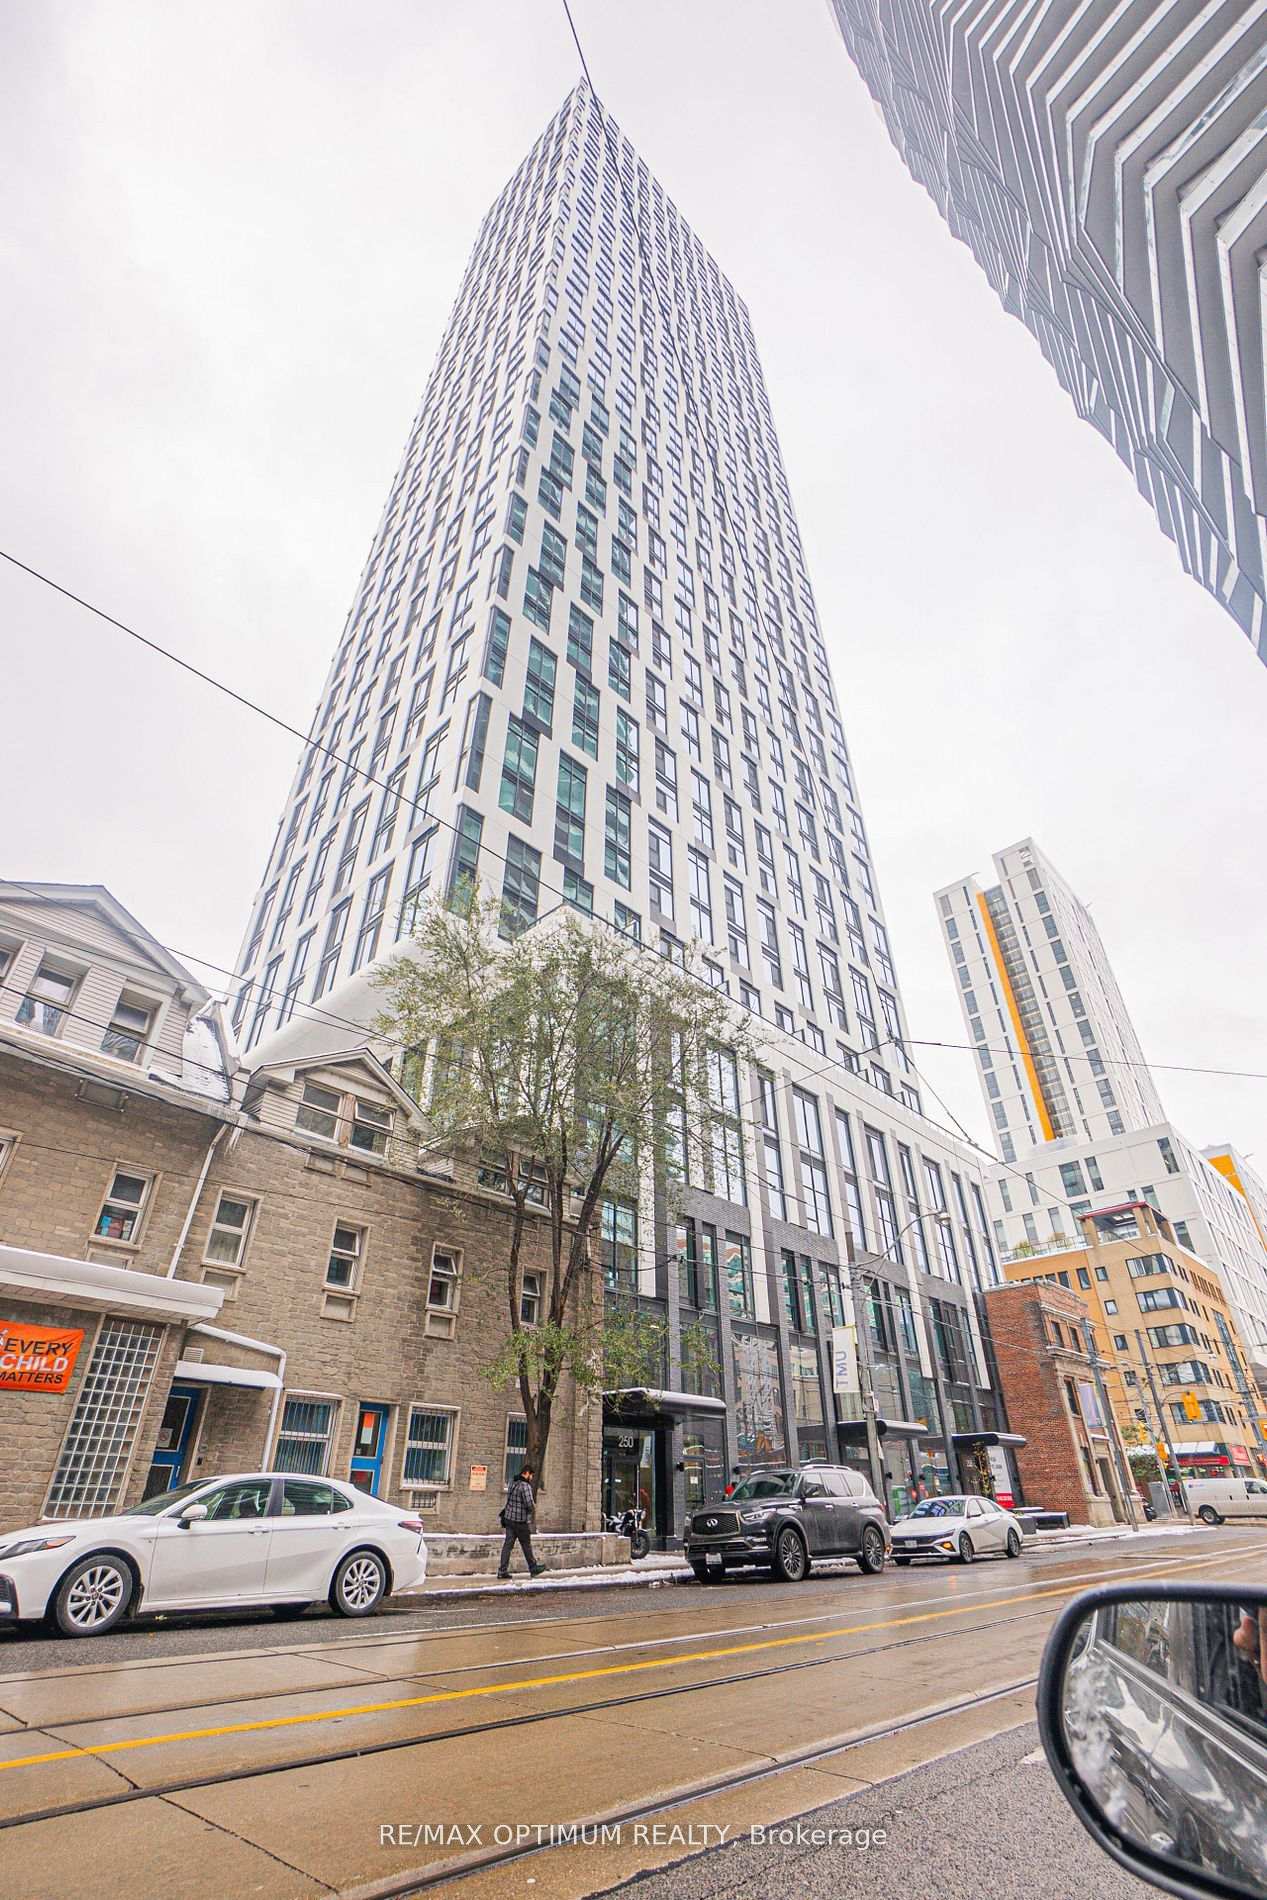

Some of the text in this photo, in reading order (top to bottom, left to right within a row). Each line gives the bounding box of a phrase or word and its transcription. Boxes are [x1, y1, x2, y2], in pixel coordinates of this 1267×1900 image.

[4, 1338, 74, 1355] EVERY
[0, 1354, 68, 1372] CHILD
[835, 1351, 848, 1389] TMU
